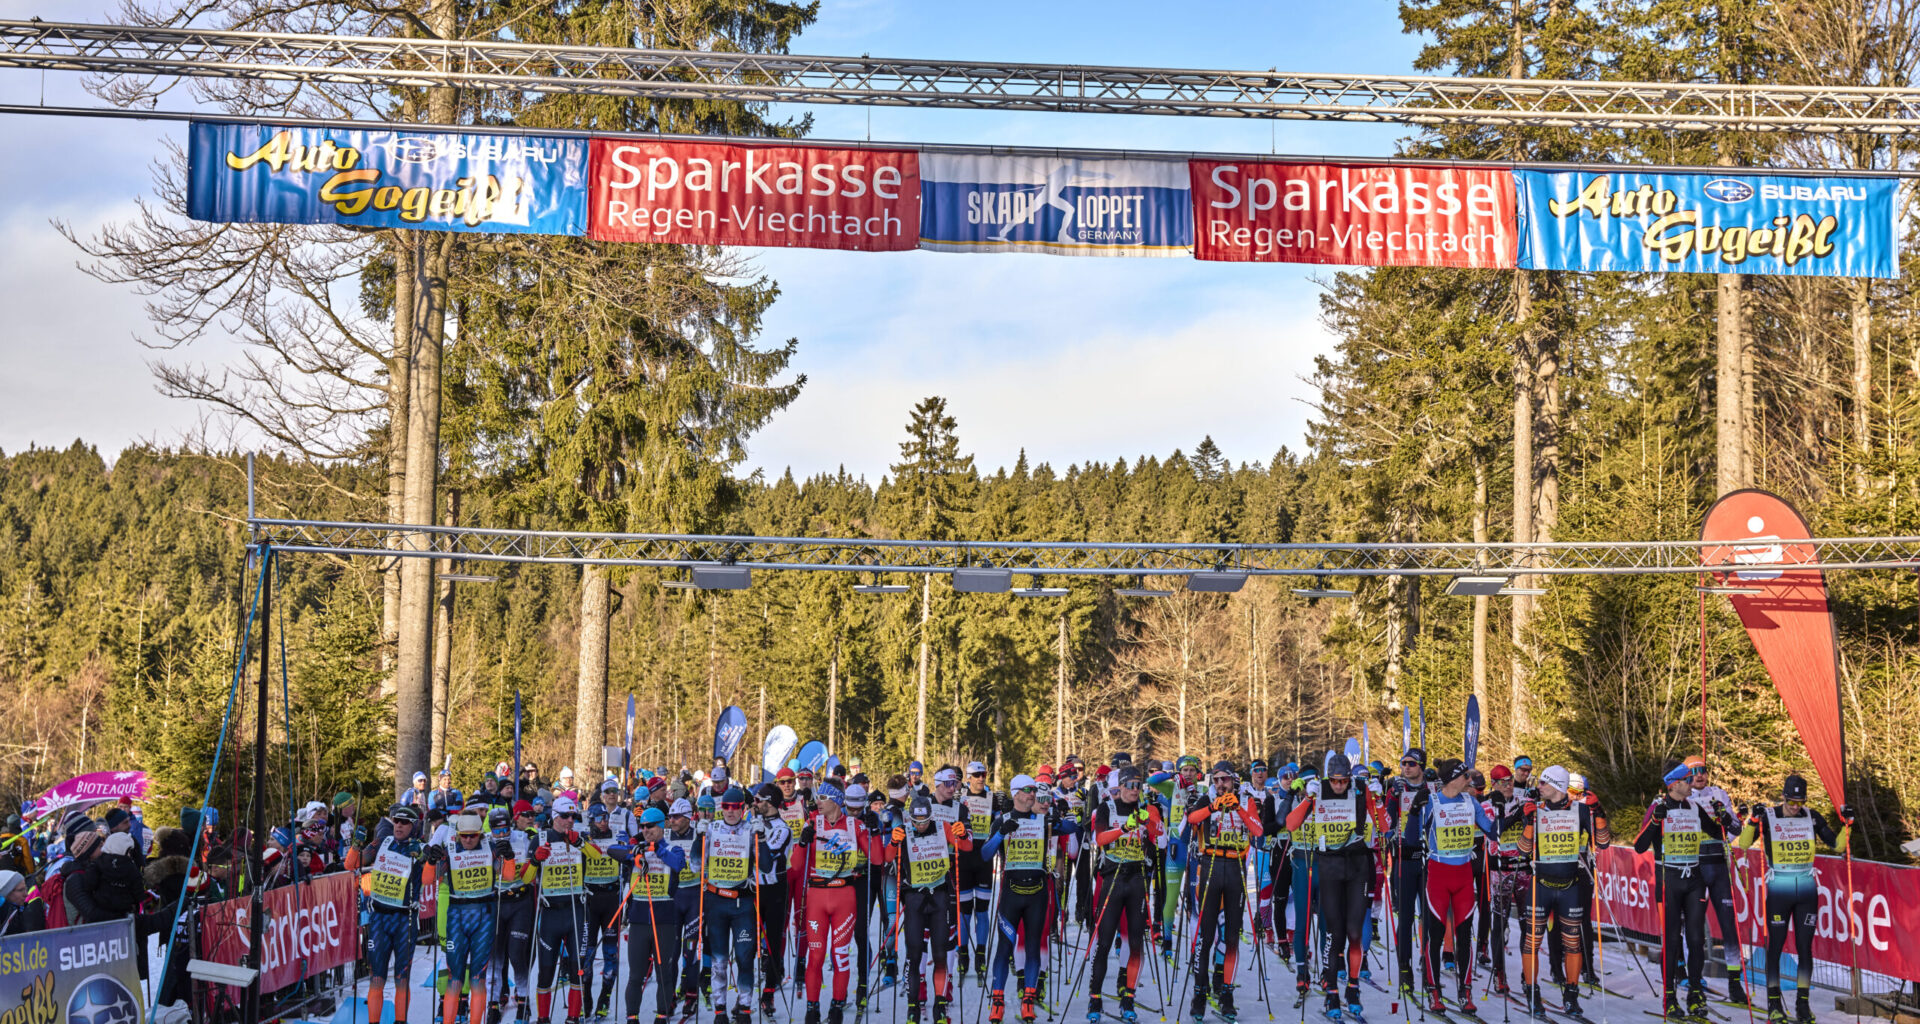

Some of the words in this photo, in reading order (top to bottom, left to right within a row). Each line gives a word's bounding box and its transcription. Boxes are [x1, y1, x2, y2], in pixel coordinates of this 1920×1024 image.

[226, 131, 361, 172] Auto
[451, 146, 558, 164] SUBARU
[609, 146, 902, 200] Sparkasse
[1210, 165, 1496, 221] Sparkasse
[1549, 175, 1677, 218] Auto
[1761, 184, 1867, 201] SUBARU
[967, 191, 1035, 224] SKADI
[1076, 195, 1144, 228] LOPPET
[608, 200, 902, 236] Regen-Viechtach
[1078, 230, 1140, 240] GERMANY
[1210, 220, 1500, 255] Regen-Viechtach
[76, 781, 139, 794] BIOTEAQUE
[1321, 823, 1351, 833] 1002
[1443, 827, 1471, 837] 1163
[1544, 833, 1574, 843] 1005
[1669, 833, 1698, 842] 1140
[1010, 840, 1038, 849] 1031
[1778, 841, 1810, 851] 1039
[715, 858, 743, 868] 1052
[916, 859, 945, 871] 1004
[457, 867, 487, 879] 1020
[547, 866, 577, 876] 1023
[376, 873, 402, 886] 1134
[59, 937, 129, 971] SUBARU
